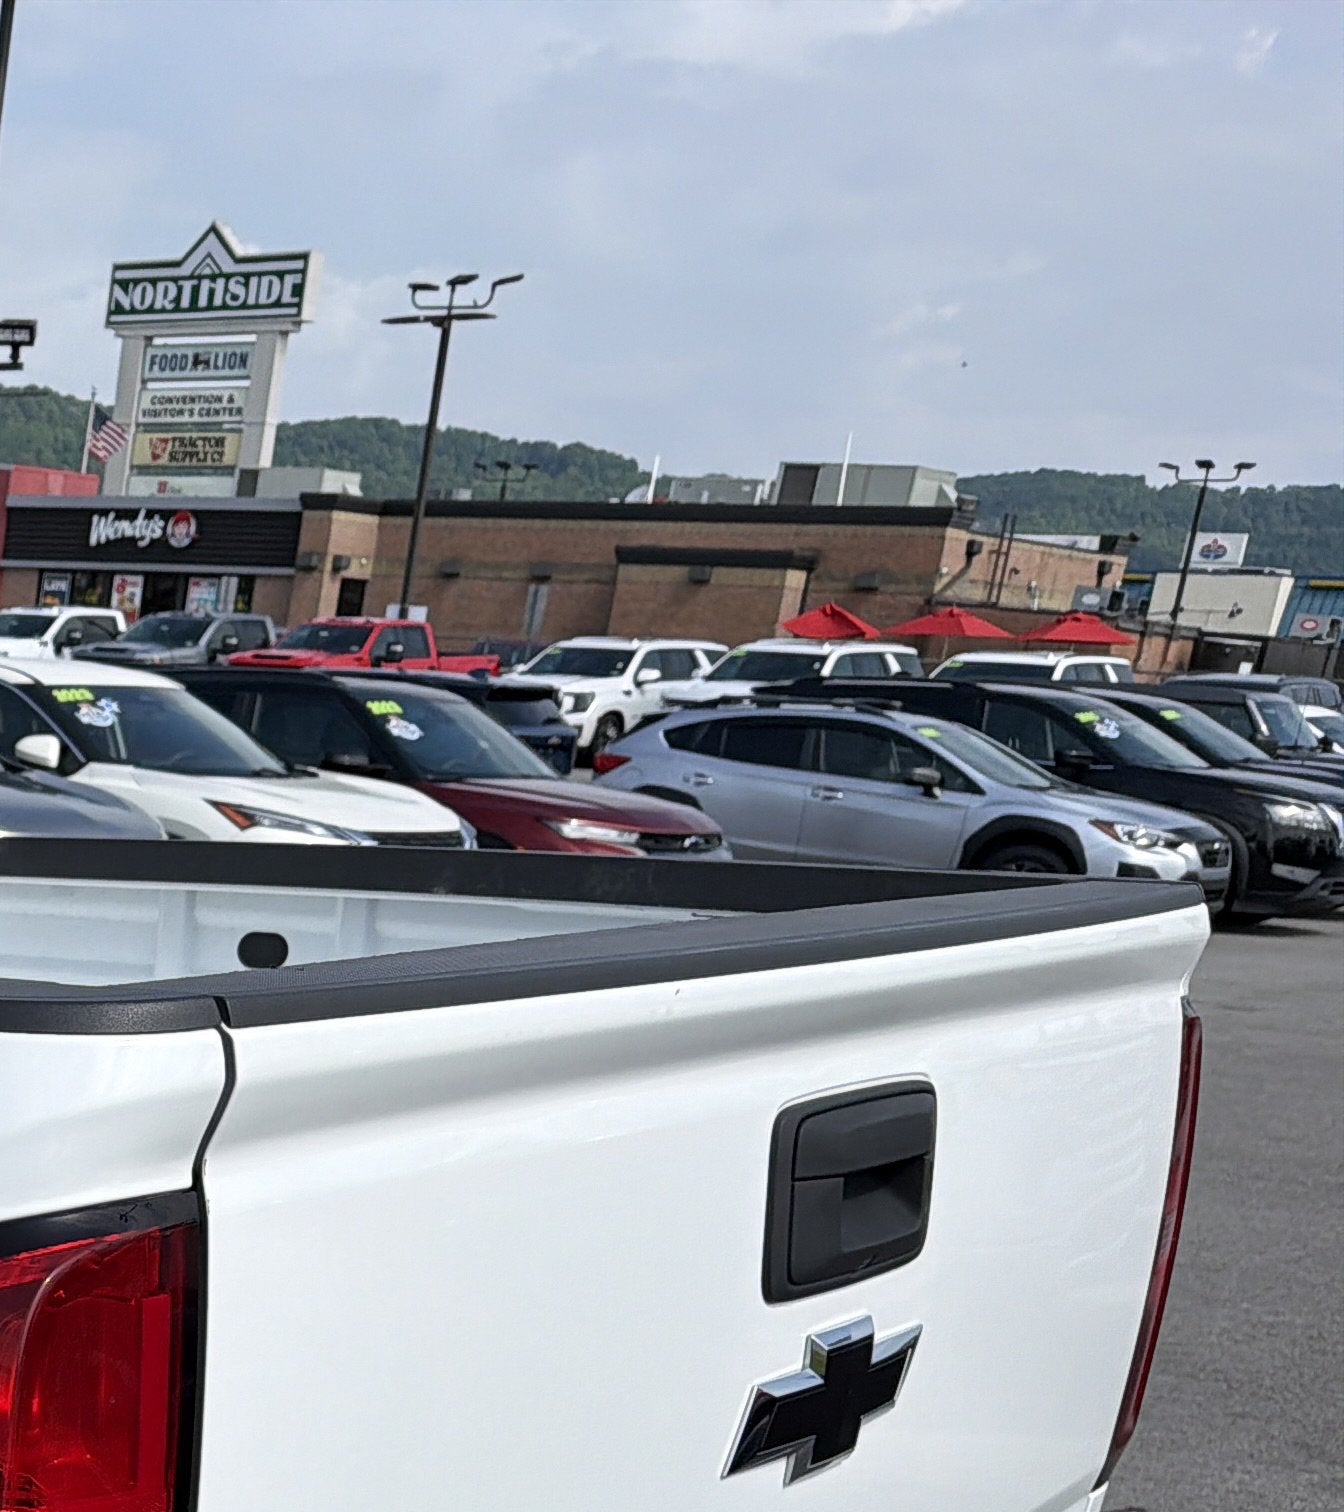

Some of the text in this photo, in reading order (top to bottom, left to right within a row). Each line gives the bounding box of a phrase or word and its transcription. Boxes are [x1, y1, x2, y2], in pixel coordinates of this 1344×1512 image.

[110, 273, 303, 312] NORTHSIDE
[148, 351, 249, 373] FOOD LION
[150, 394, 224, 406] CONVENTION
[198, 406, 243, 418] CENTER
[171, 436, 226, 449] TRACTOR
[168, 450, 210, 463] SUPPLY
[89, 507, 165, 547] Wendy's
